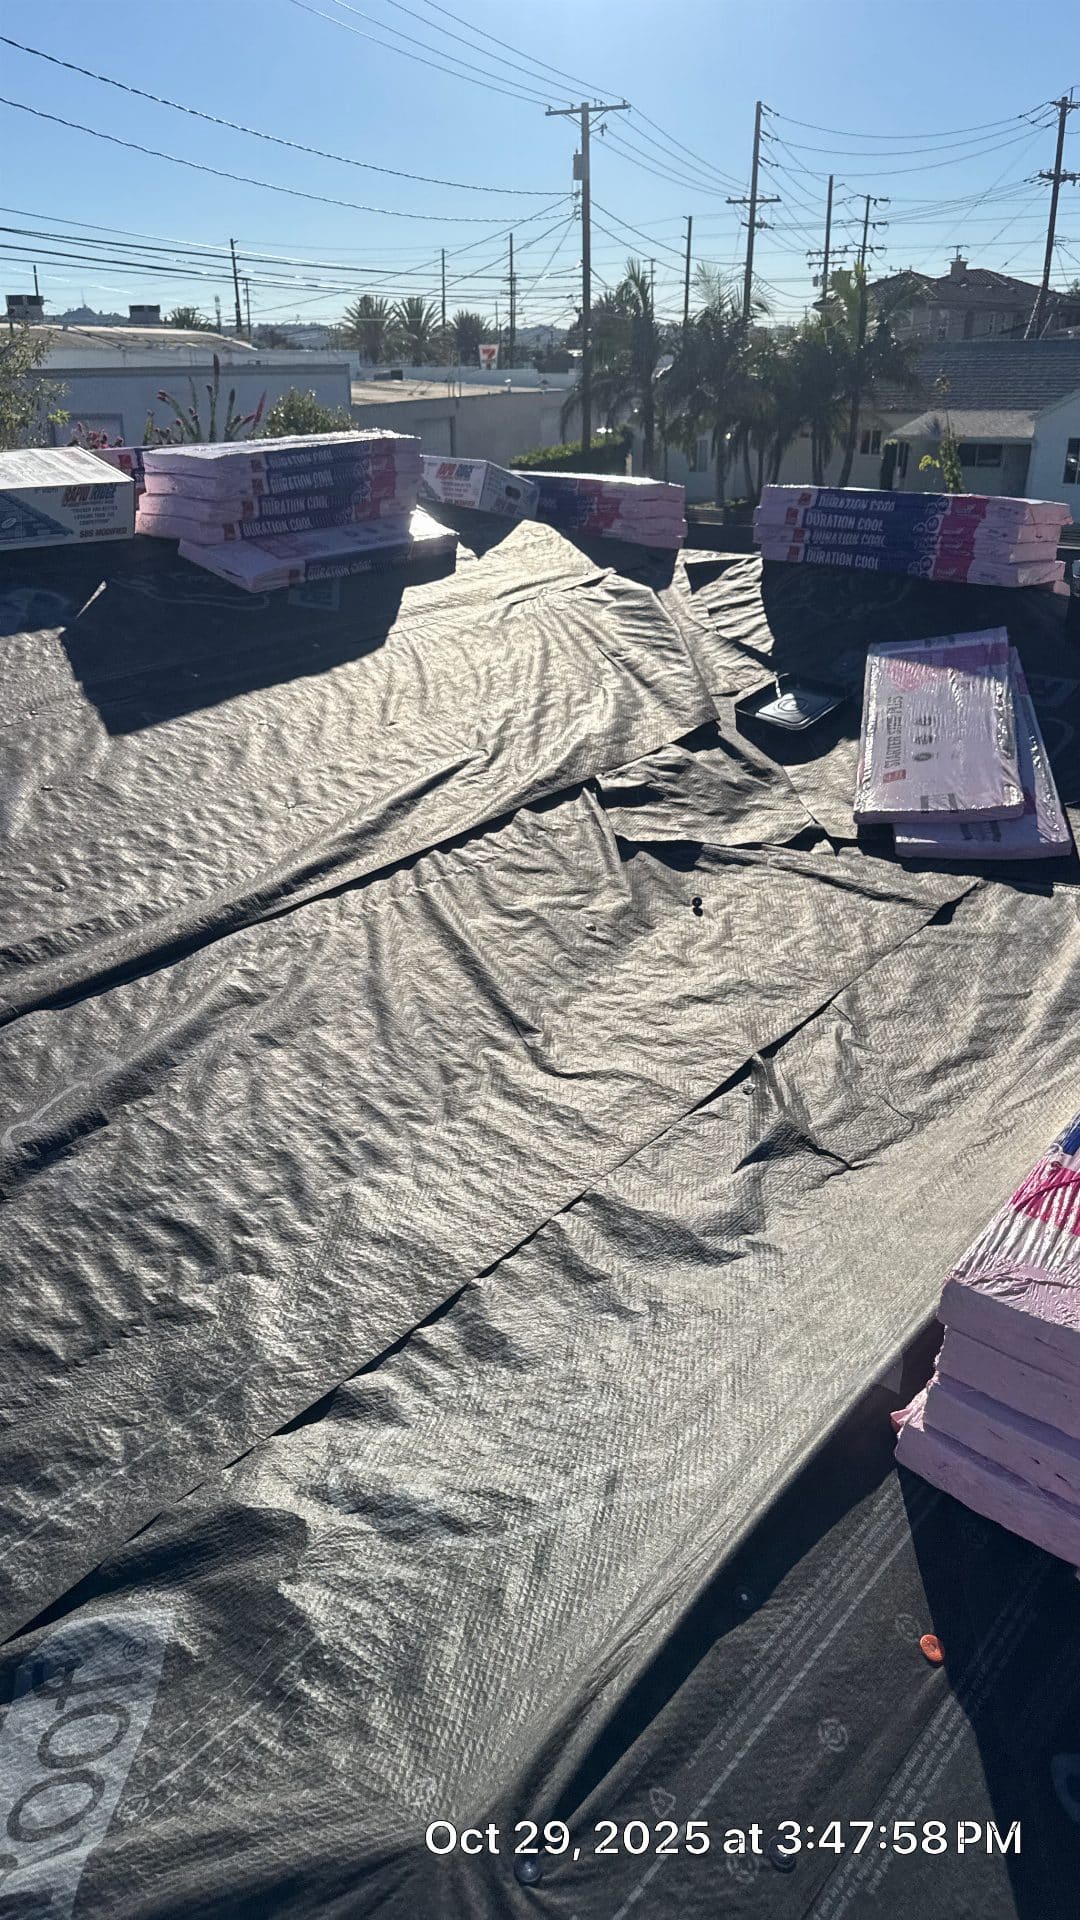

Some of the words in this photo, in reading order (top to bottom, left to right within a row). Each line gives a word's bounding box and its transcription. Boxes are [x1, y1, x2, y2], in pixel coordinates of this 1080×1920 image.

[242, 520, 289, 537] DURATION
[806, 511, 855, 529] DURATION
[858, 517, 884, 533] COOL
[811, 531, 860, 546] DURATION
[806, 549, 852, 567] DURATION
[854, 554, 880, 571] COOL
[884, 735, 902, 769] STARTER
